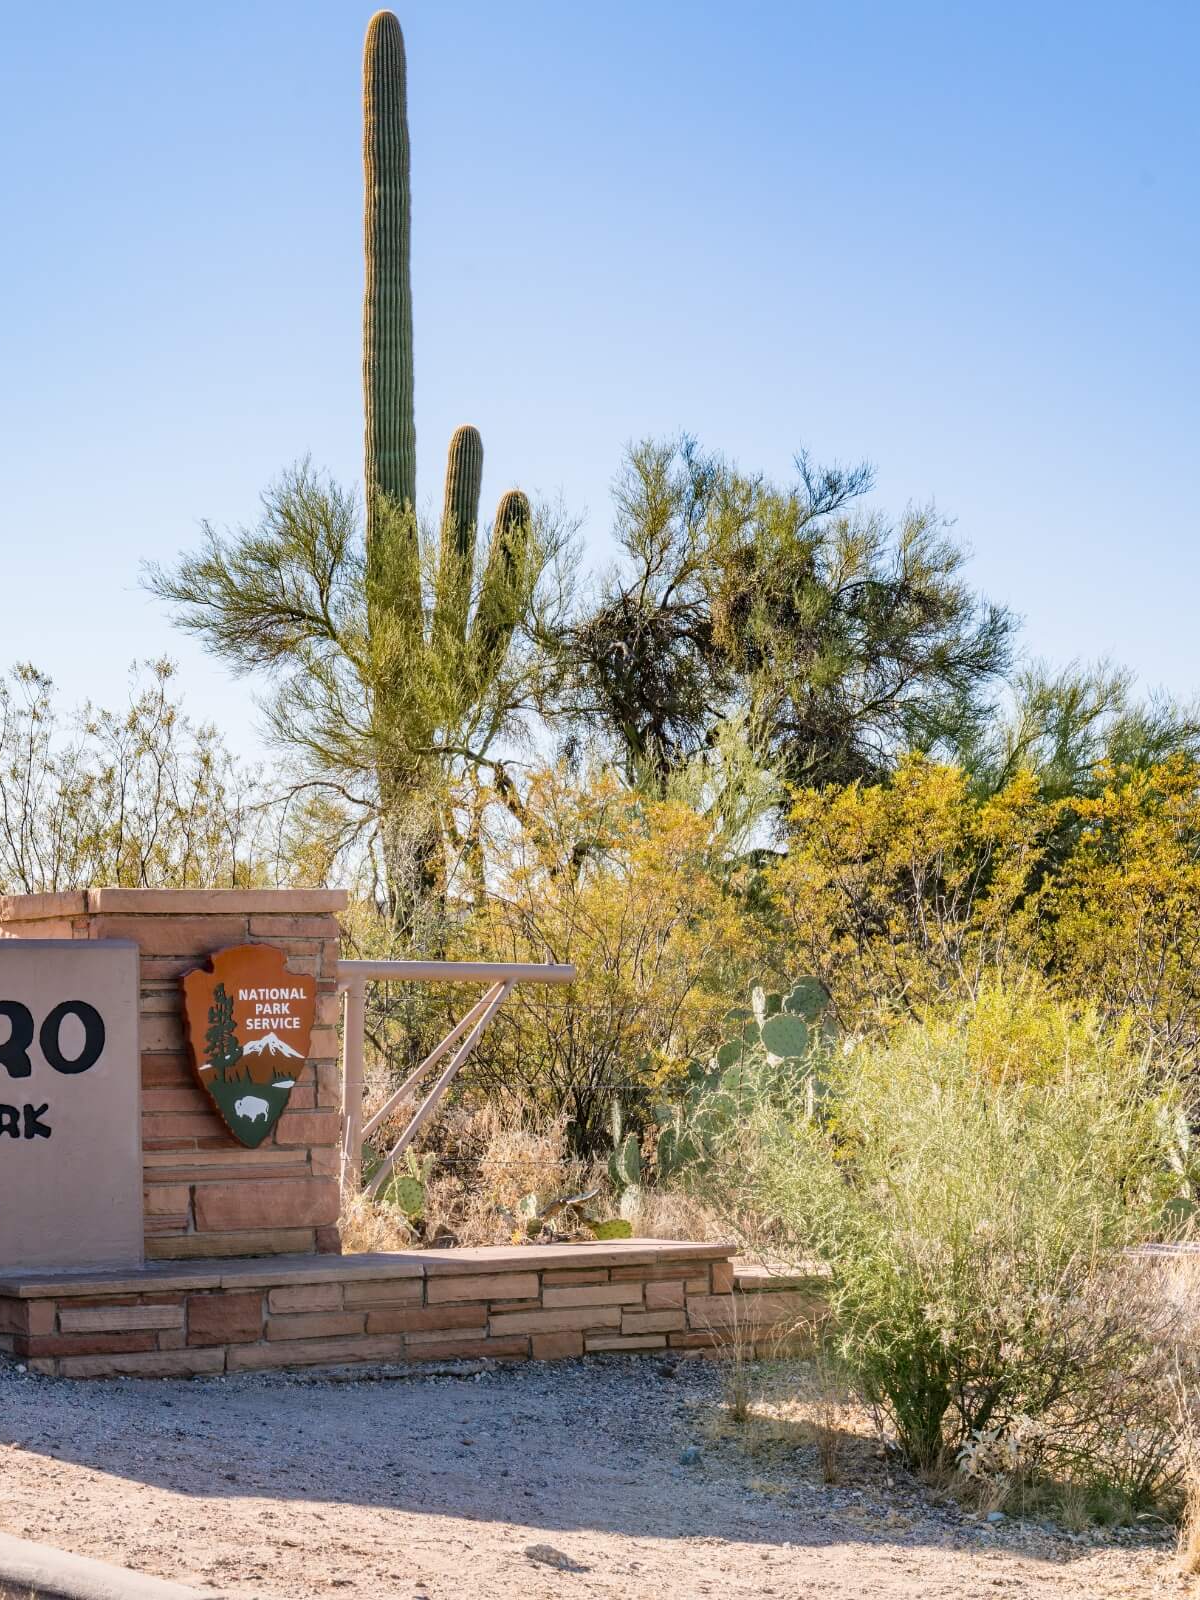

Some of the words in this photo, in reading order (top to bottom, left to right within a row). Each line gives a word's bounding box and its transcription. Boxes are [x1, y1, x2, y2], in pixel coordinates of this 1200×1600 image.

[239, 988, 307, 1000] NATIONAL
[255, 1003, 290, 1015] PARK
[246, 1017, 300, 1030] SERVICE
